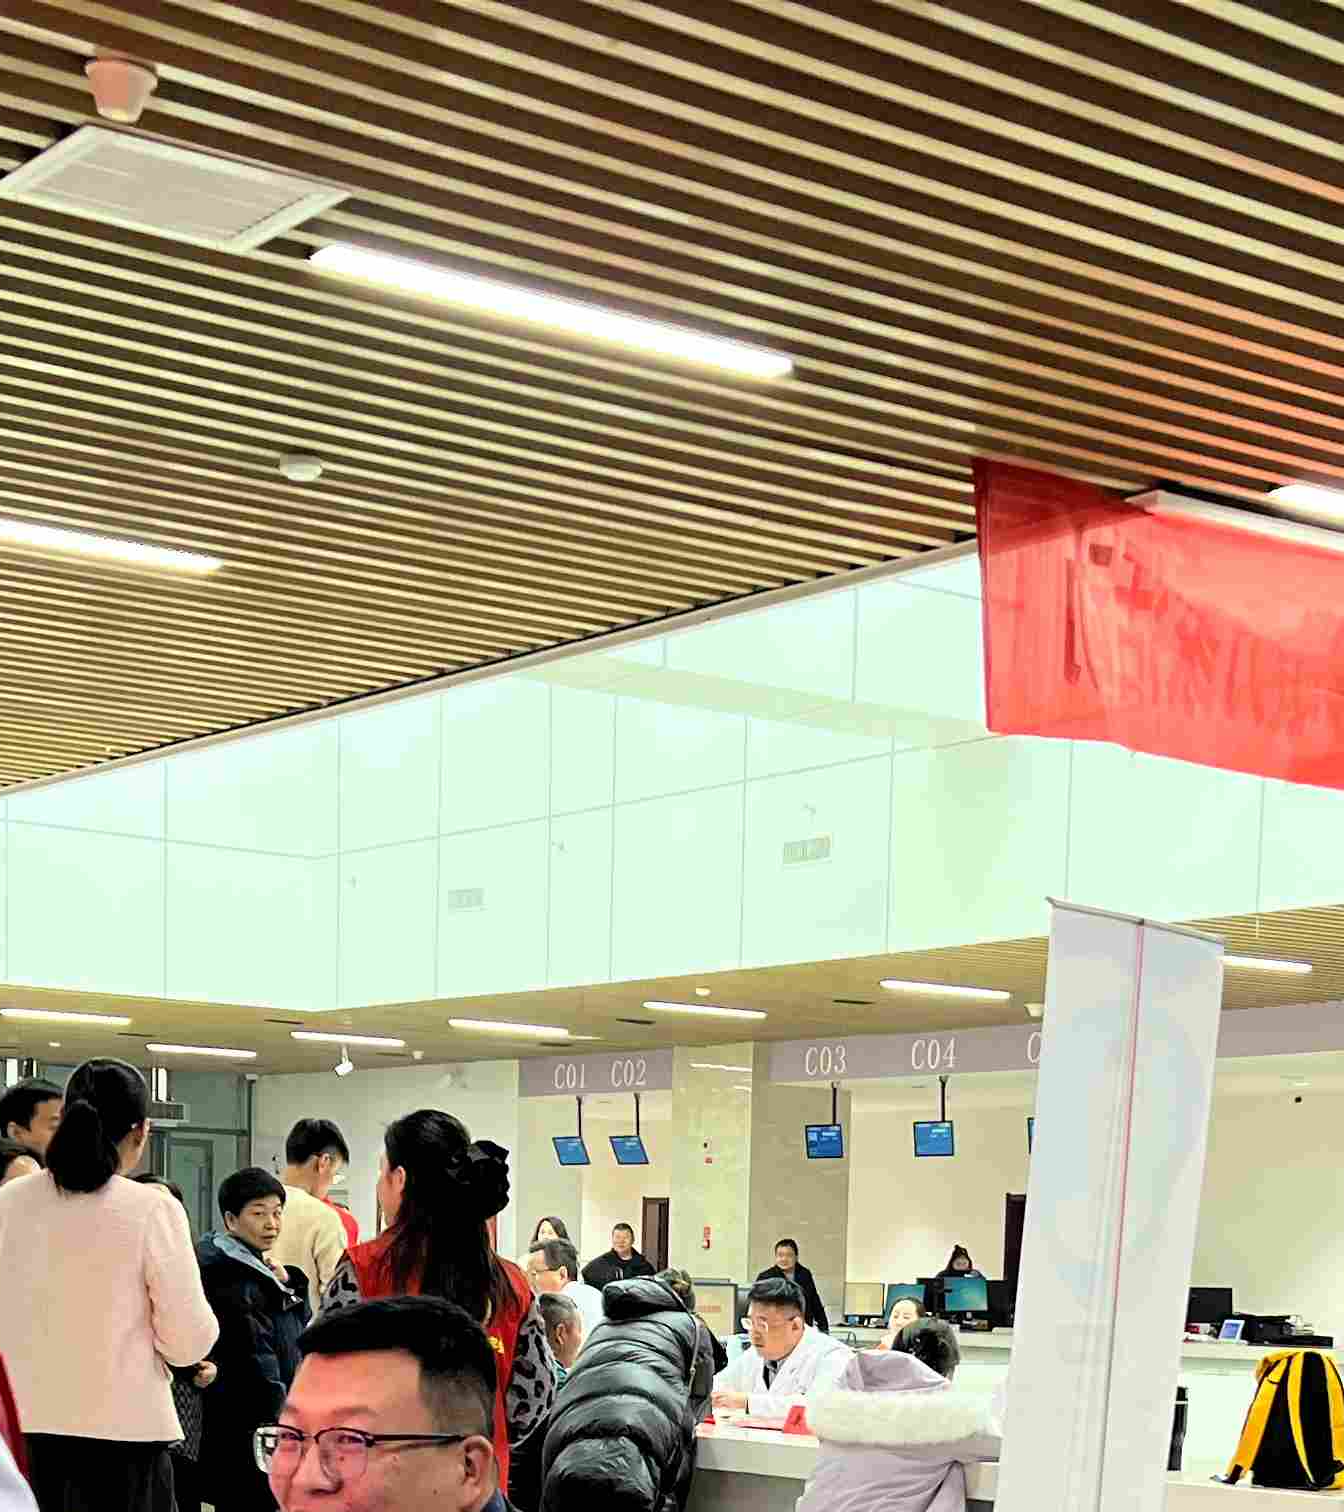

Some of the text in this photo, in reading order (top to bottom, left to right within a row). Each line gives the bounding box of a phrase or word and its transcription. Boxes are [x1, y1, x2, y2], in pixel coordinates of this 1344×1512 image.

[805, 1045, 847, 1075] C03
[911, 1038, 957, 1071] C04
[554, 1063, 586, 1090] C01
[610, 1059, 647, 1088] C02
